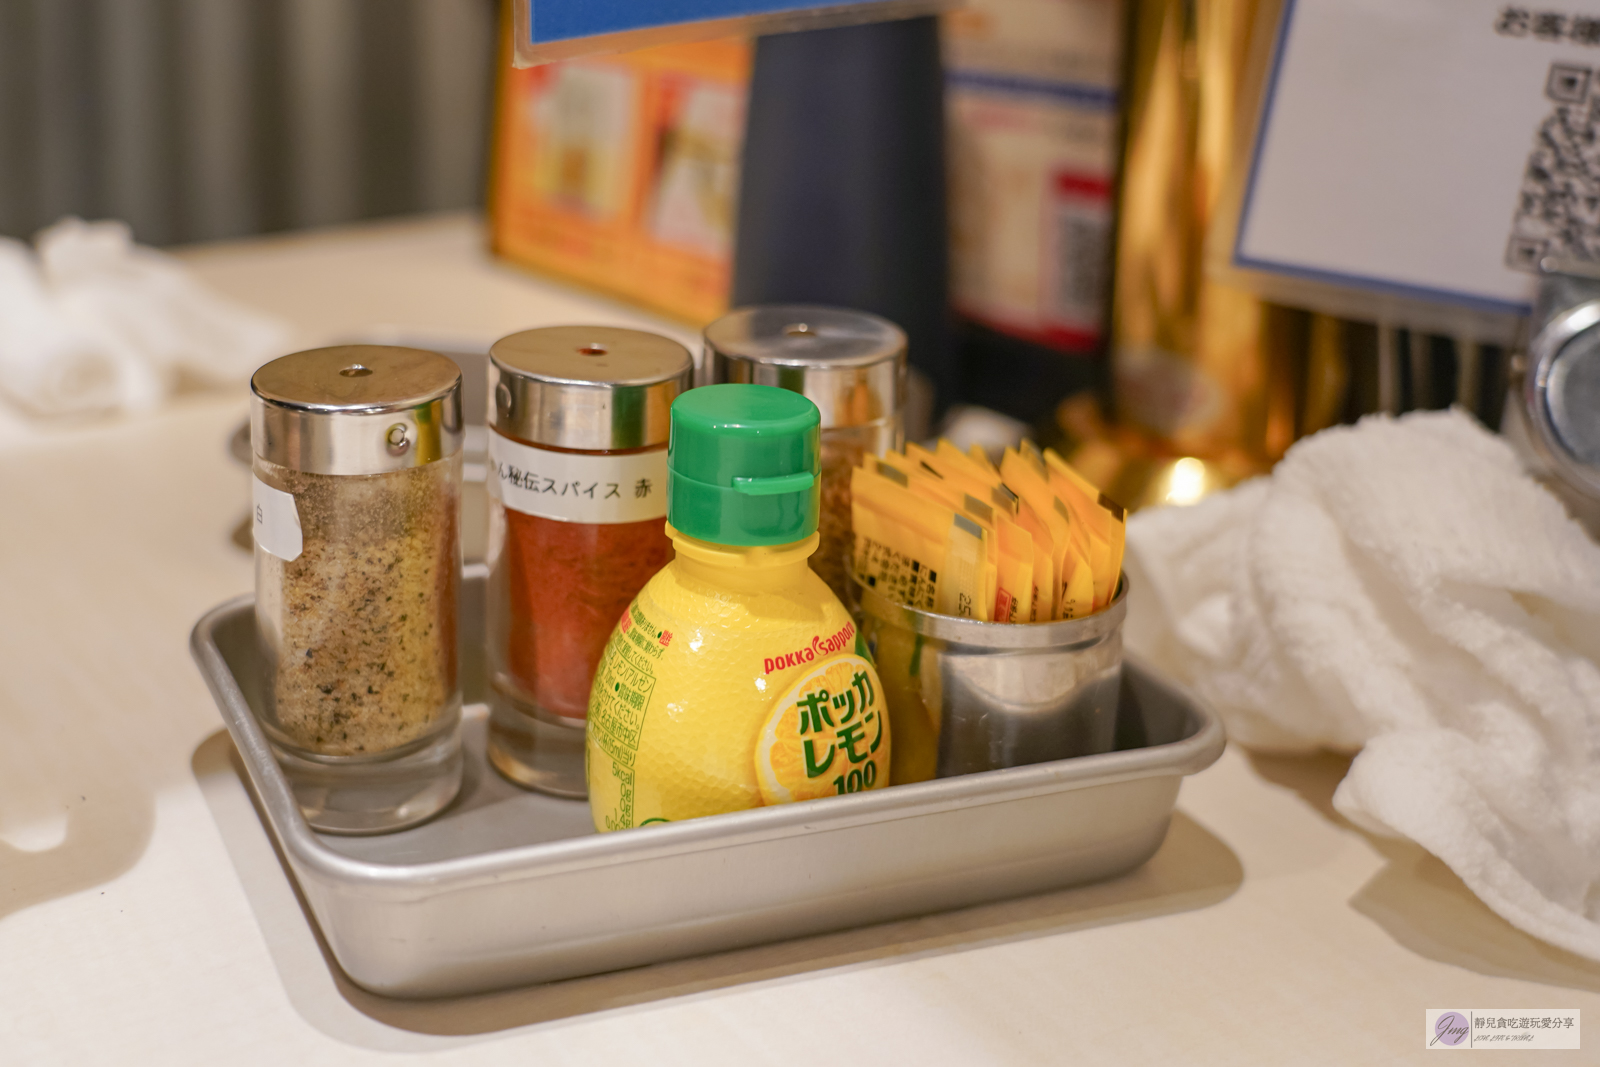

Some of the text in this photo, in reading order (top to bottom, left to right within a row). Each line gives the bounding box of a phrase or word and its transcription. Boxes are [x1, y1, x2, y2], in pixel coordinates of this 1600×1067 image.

[635, 478, 653, 499] 赤
[796, 670, 875, 736] ポッカ
[803, 710, 883, 779] レモン
[832, 759, 877, 796] 100
